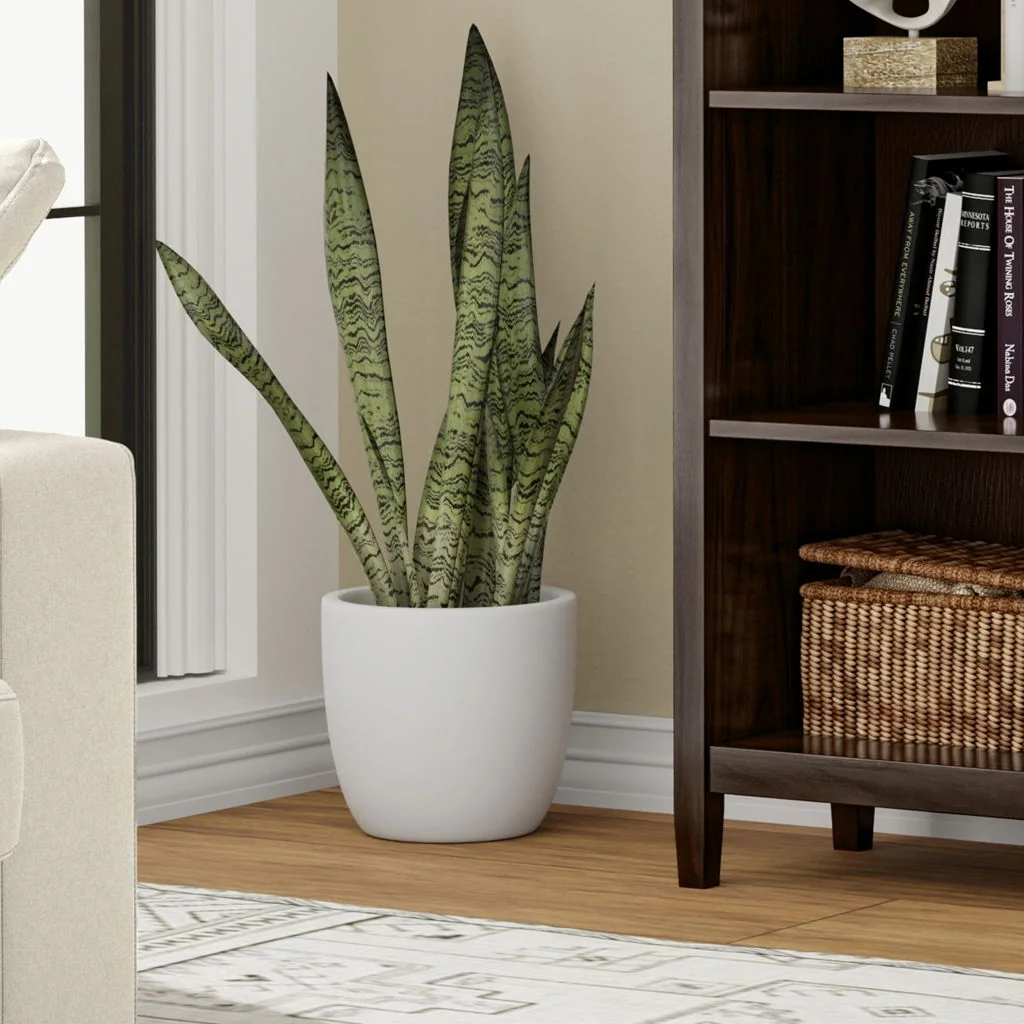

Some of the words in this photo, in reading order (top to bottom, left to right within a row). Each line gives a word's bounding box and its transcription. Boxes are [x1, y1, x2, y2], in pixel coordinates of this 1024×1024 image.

[906, 211, 916, 235] AWAY
[902, 234, 913, 260] FROM
[894, 262, 908, 318] EVERYWHERE
[888, 328, 899, 351] CHAD
[884, 352, 895, 379] PELLEY
[1004, 343, 1015, 375] Nabina
[1004, 375, 1015, 392] Das
